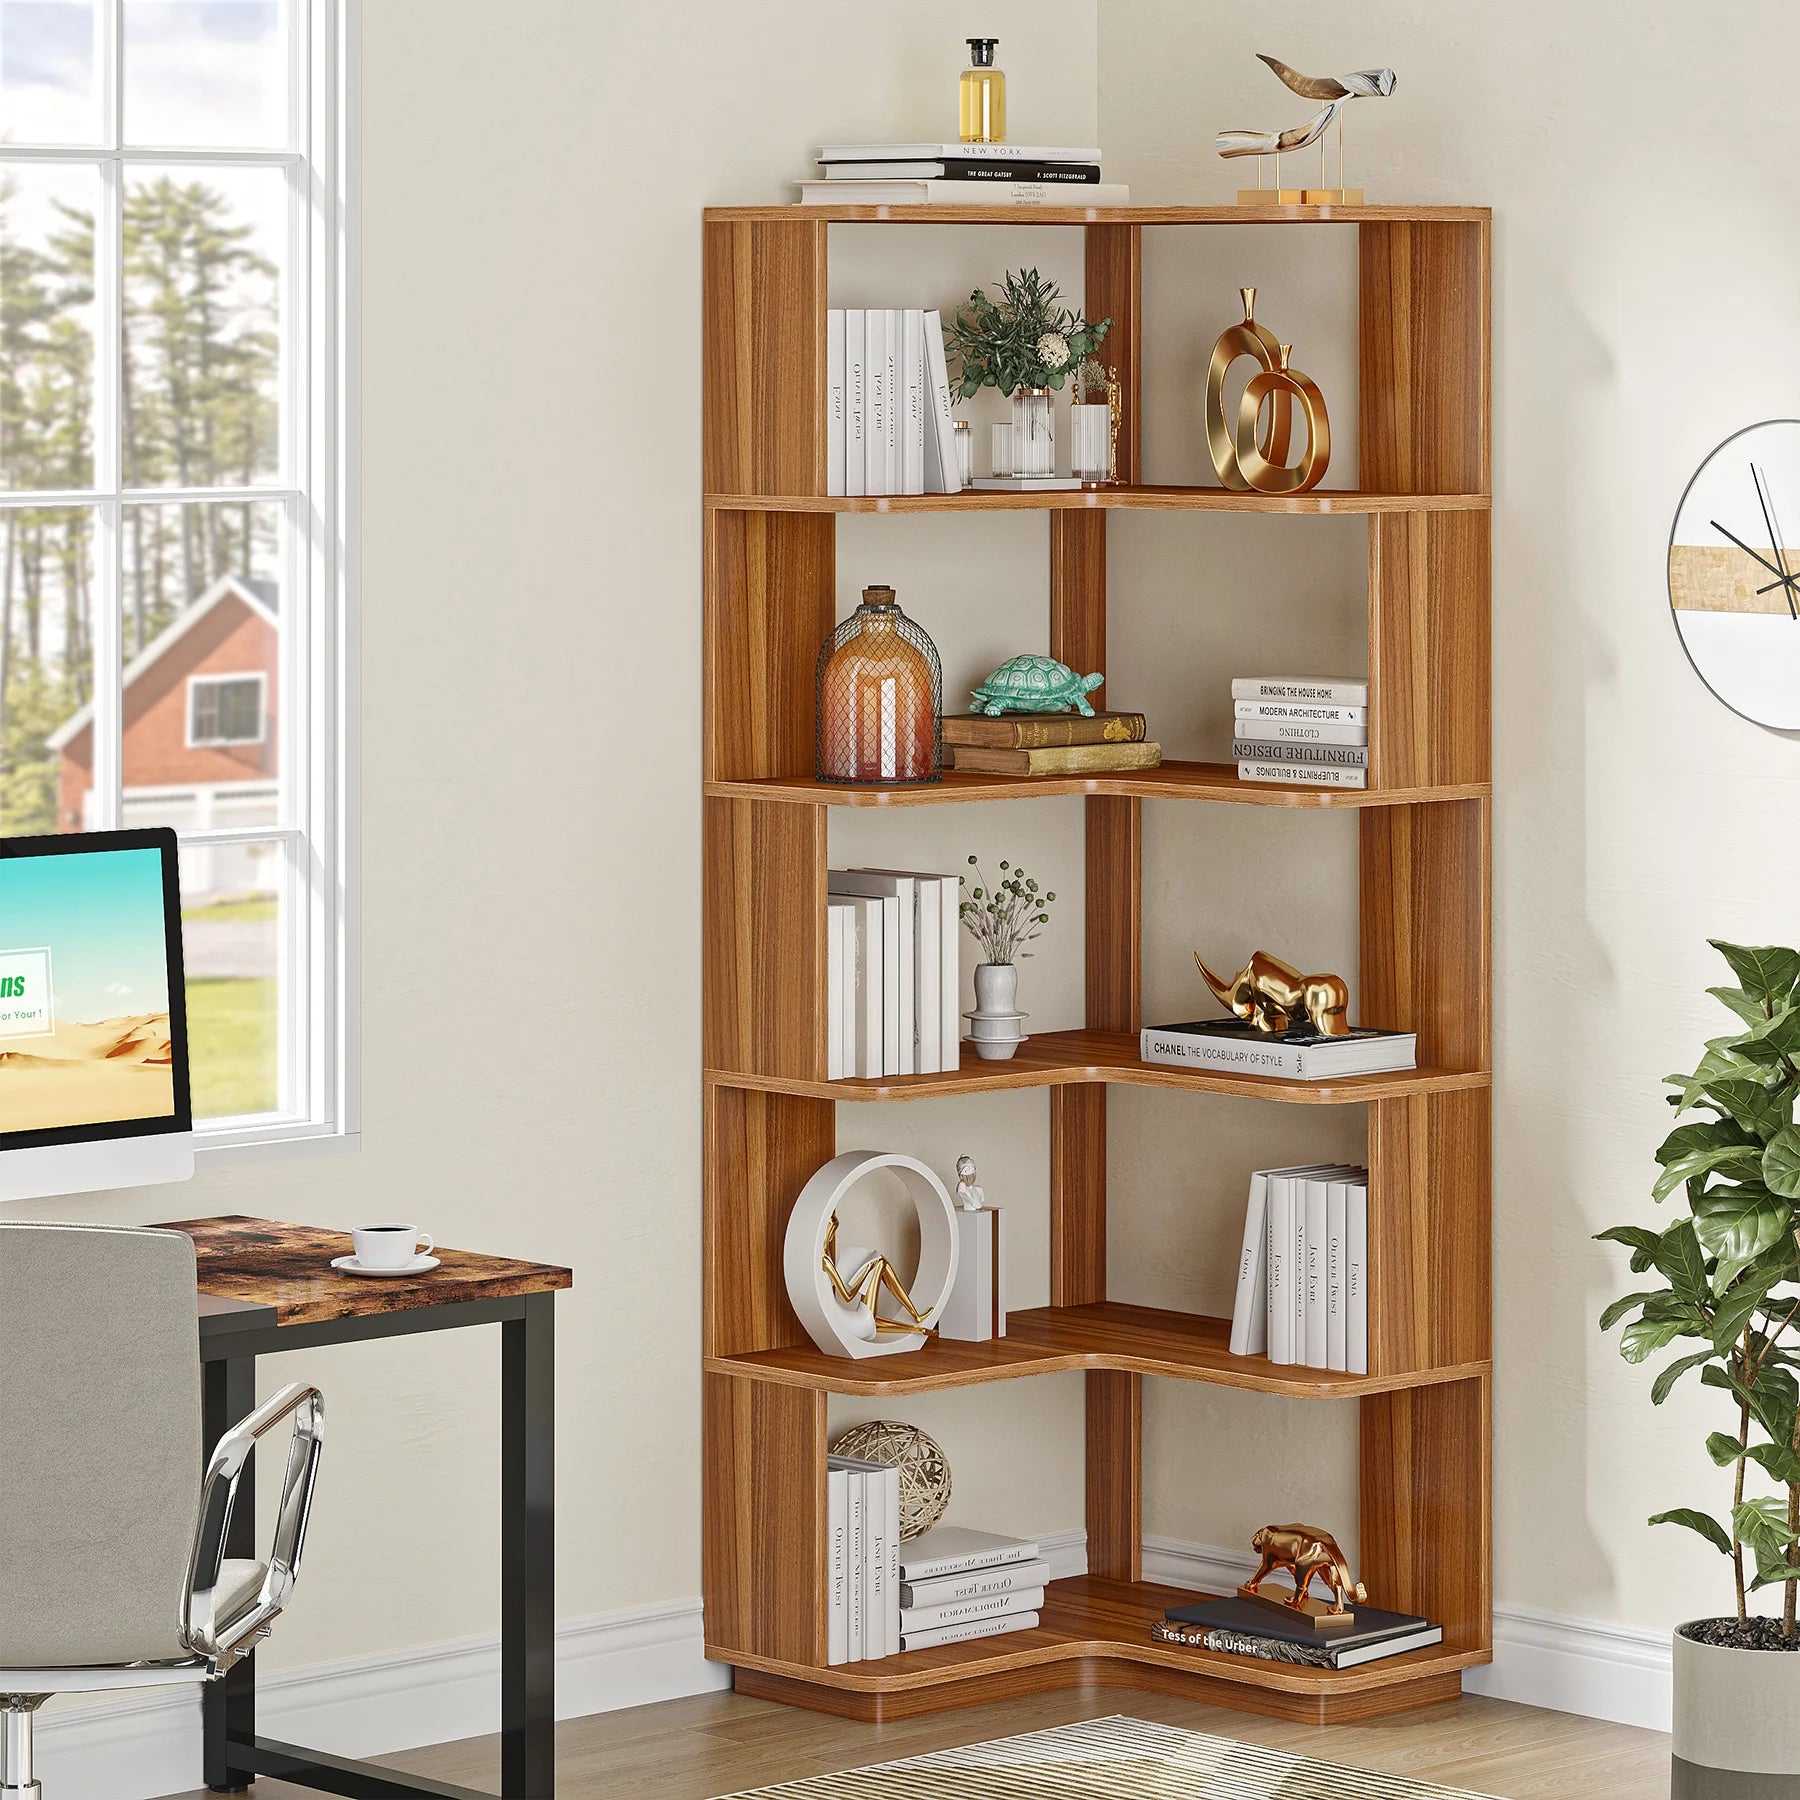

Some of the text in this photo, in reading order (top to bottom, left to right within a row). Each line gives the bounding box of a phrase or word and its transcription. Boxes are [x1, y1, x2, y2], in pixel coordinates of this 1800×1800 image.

[963, 147, 1022, 156] NEW YORK
[967, 170, 1013, 179] THE GREAT GATSBY
[1043, 172, 1058, 180] SCOTT
[1260, 685, 1332, 699] BRINGING THE HOUSE HOME
[1259, 706, 1288, 717] MODERN
[1289, 708, 1339, 720] ARCHITECTURE
[1279, 728, 1320, 739] CLOTHING
[1234, 744, 1364, 764] FURNITURE DESIGN
[1256, 766, 1291, 778] BUILDINGS
[1292, 770, 1297, 778] &
[1299, 770, 1340, 781] BLUEPRINTS
[14, 1010, 36, 1019] Your
[1154, 1042, 1186, 1056] CHANEL
[1187, 1046, 1201, 1057] THE
[1202, 1048, 1249, 1063] VOCABULARY
[1250, 1053, 1260, 1064] OF
[1261, 1054, 1283, 1066] STYLE
[1241, 1248, 1252, 1281] EMMA
[1274, 1254, 1282, 1288] EMMA
[1309, 1244, 1318, 1304] JANE EYRE
[1331, 1237, 1339, 1316] OLIVER TWIST
[1351, 1263, 1360, 1297] EMMA
[835, 1527, 844, 1608] OLIVER TWIST
[874, 1536, 883, 1596] JANE EYRE
[1162, 1628, 1258, 1654] Tess of the Urber
